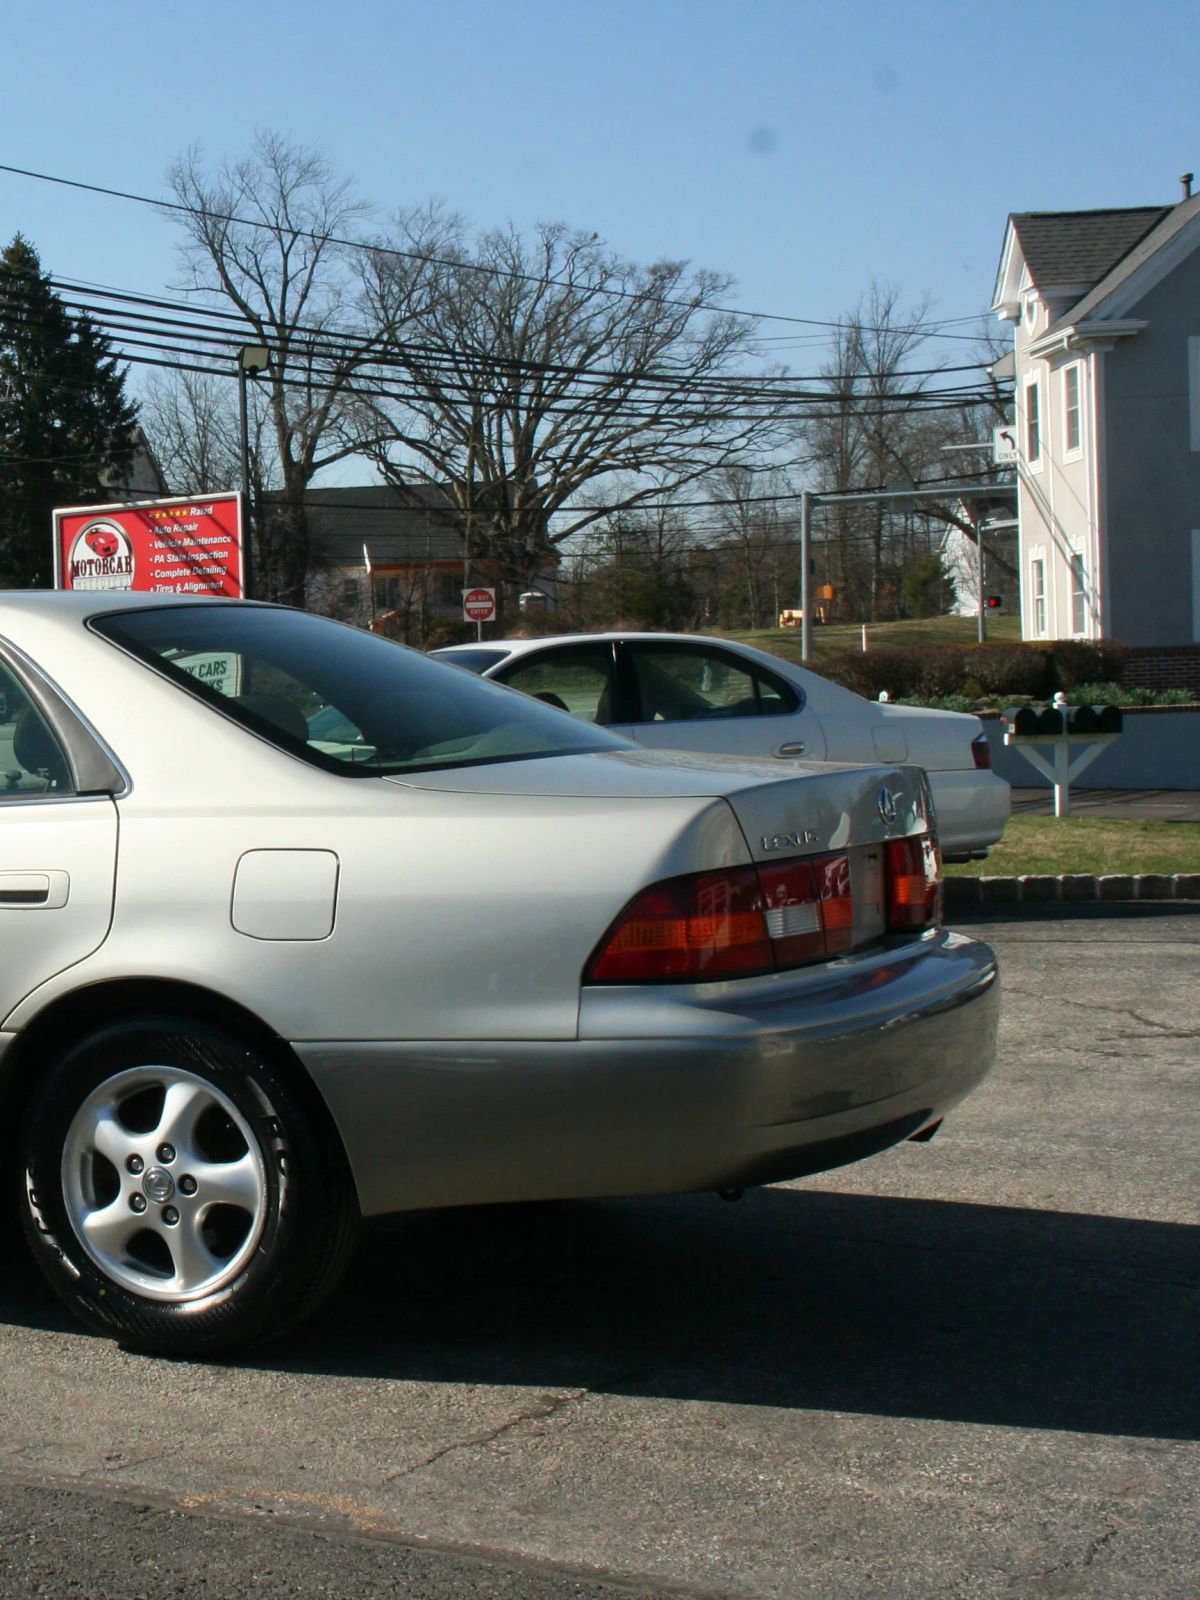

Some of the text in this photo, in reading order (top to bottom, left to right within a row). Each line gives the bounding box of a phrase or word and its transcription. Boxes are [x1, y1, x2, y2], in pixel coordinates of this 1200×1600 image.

[998, 452, 1017, 460] ONLY
[190, 506, 213, 516] Rated
[154, 522, 198, 534] Auto Repair
[154, 536, 232, 549] Vehicle Maintenance
[154, 550, 229, 563] PA State Inspection
[71, 555, 133, 577] MOTORCAR
[154, 564, 227, 579] Complete Detailing
[155, 580, 224, 593] Tires & Alignment
[198, 660, 227, 678] CARS
